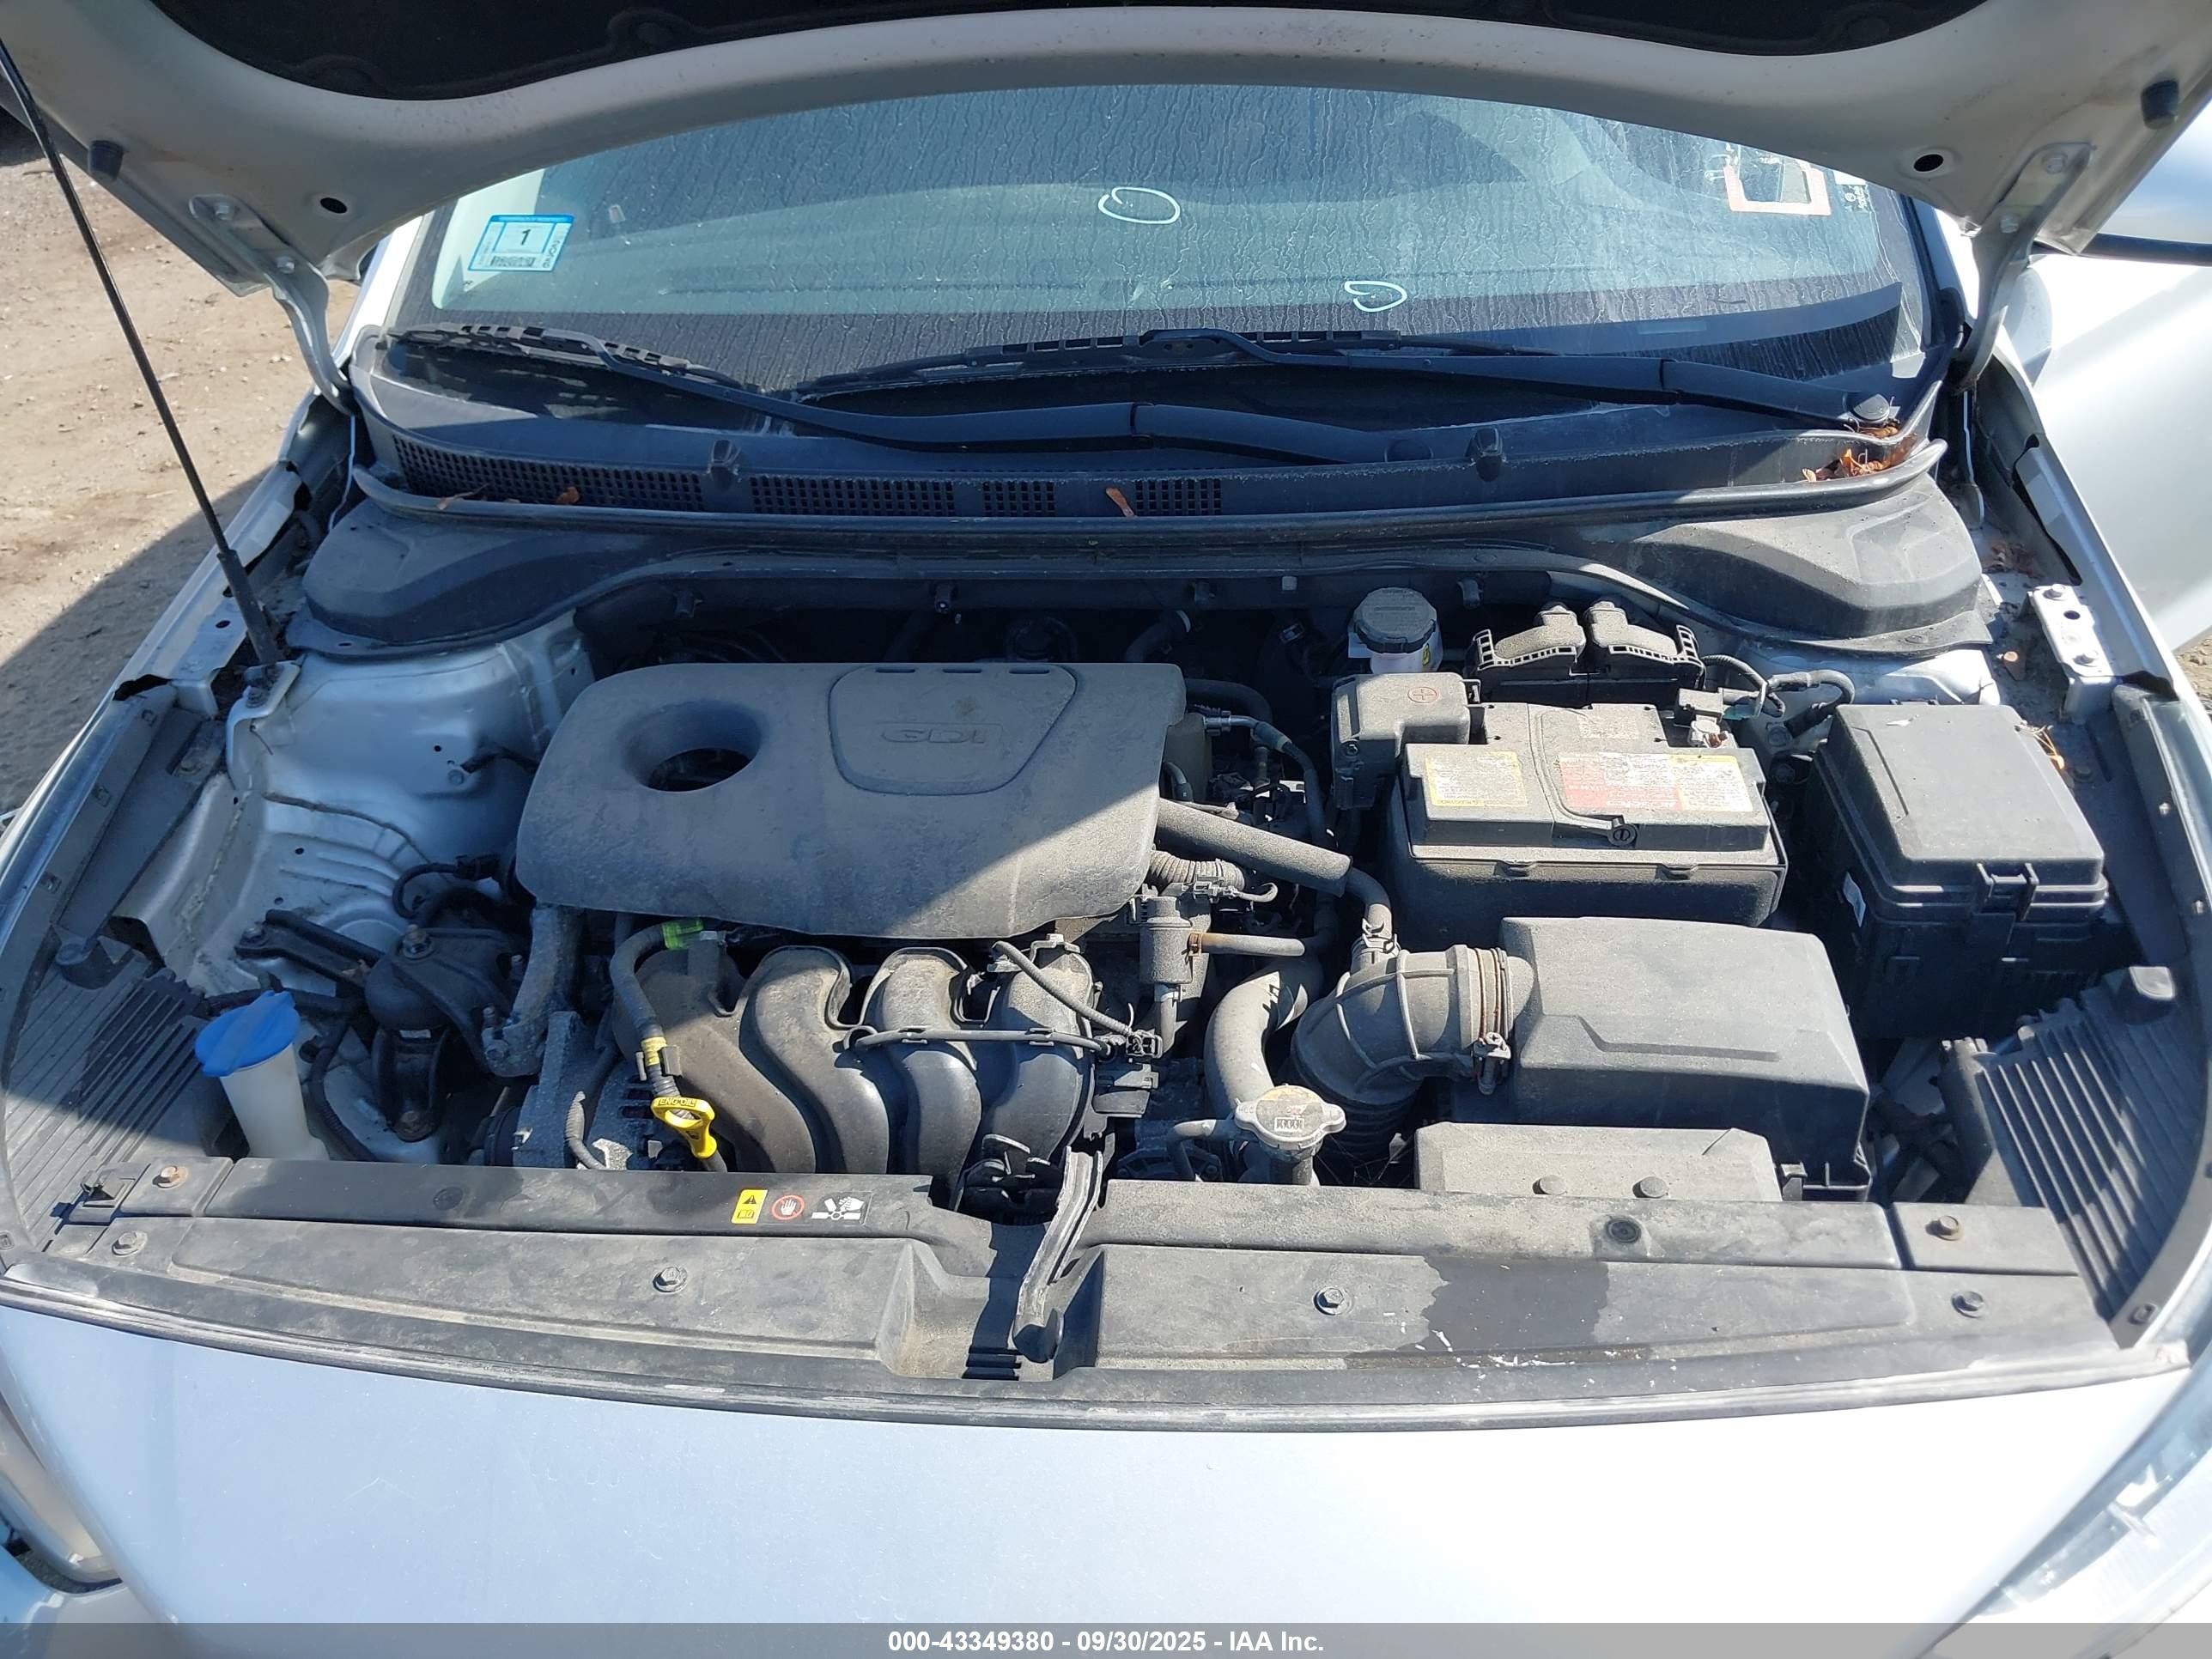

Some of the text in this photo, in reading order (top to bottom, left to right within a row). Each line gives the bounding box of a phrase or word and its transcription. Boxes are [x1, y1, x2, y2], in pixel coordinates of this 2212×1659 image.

[520, 228, 531, 245] 1
[880, 728, 987, 744] GDI
[659, 1097, 678, 1106] ENG
